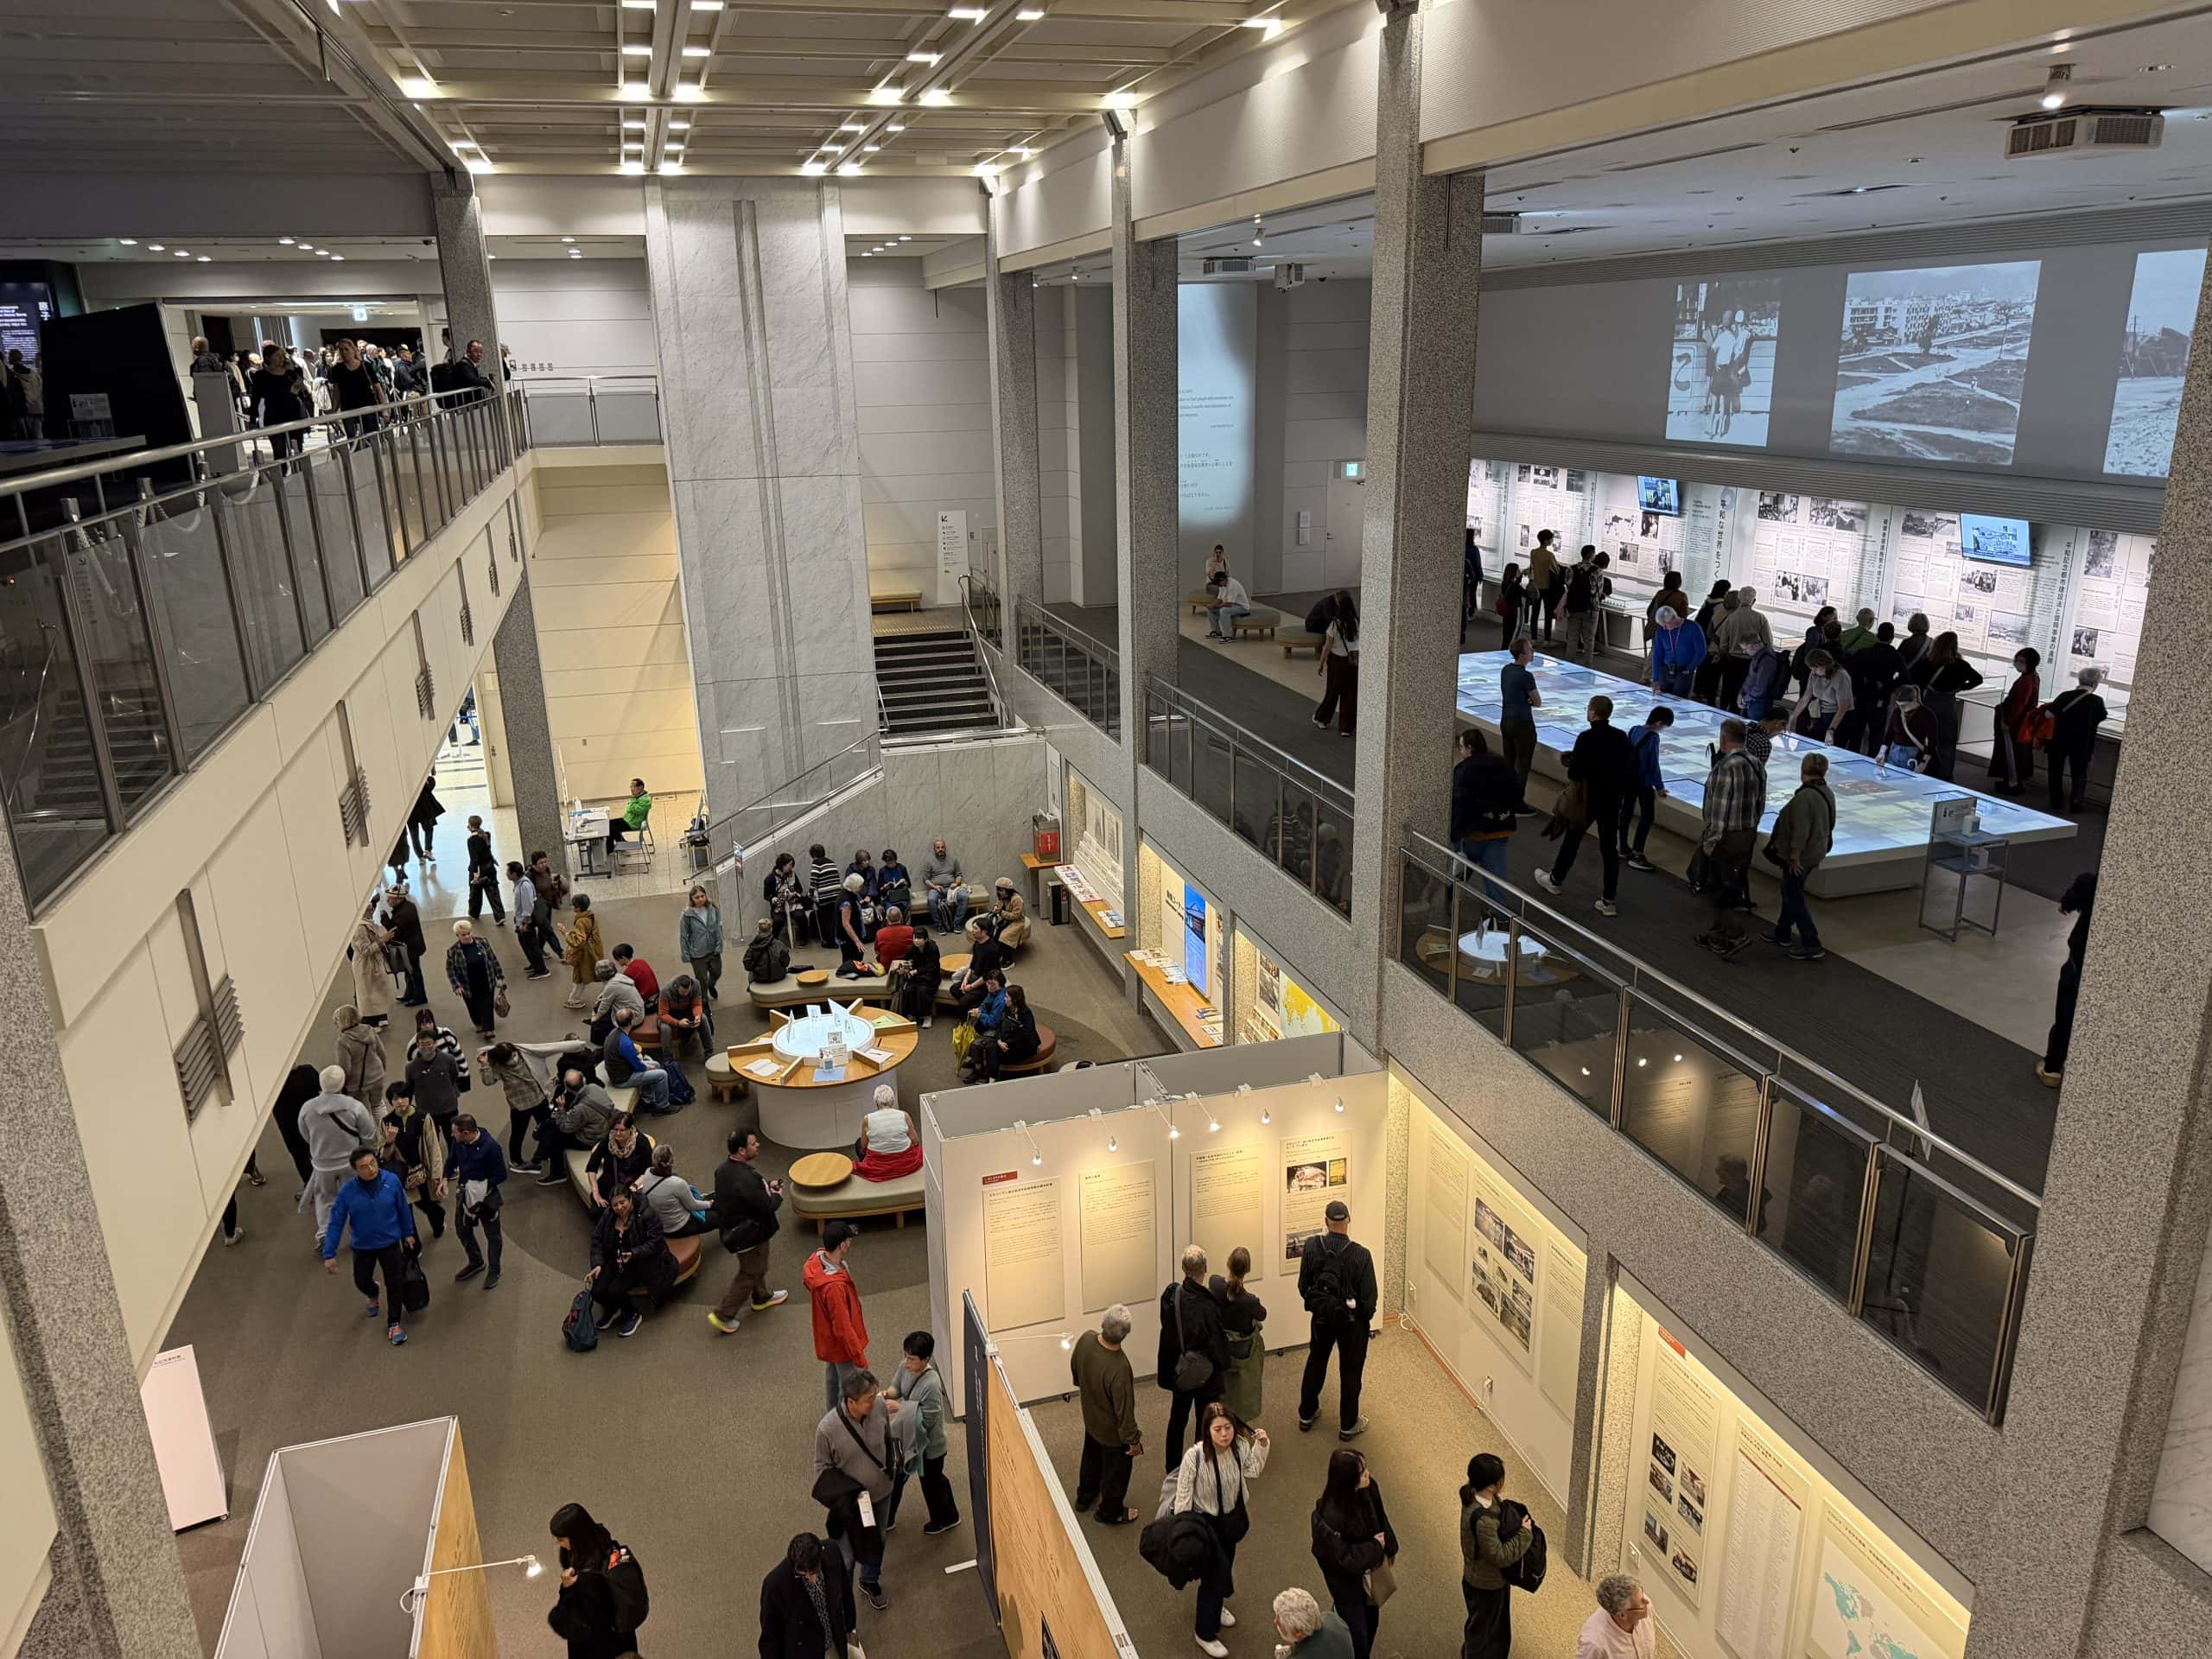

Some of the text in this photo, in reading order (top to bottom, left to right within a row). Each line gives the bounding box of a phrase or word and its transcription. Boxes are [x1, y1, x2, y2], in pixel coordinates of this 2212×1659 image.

[1713, 499, 1727, 582] 平和な世界をつく
